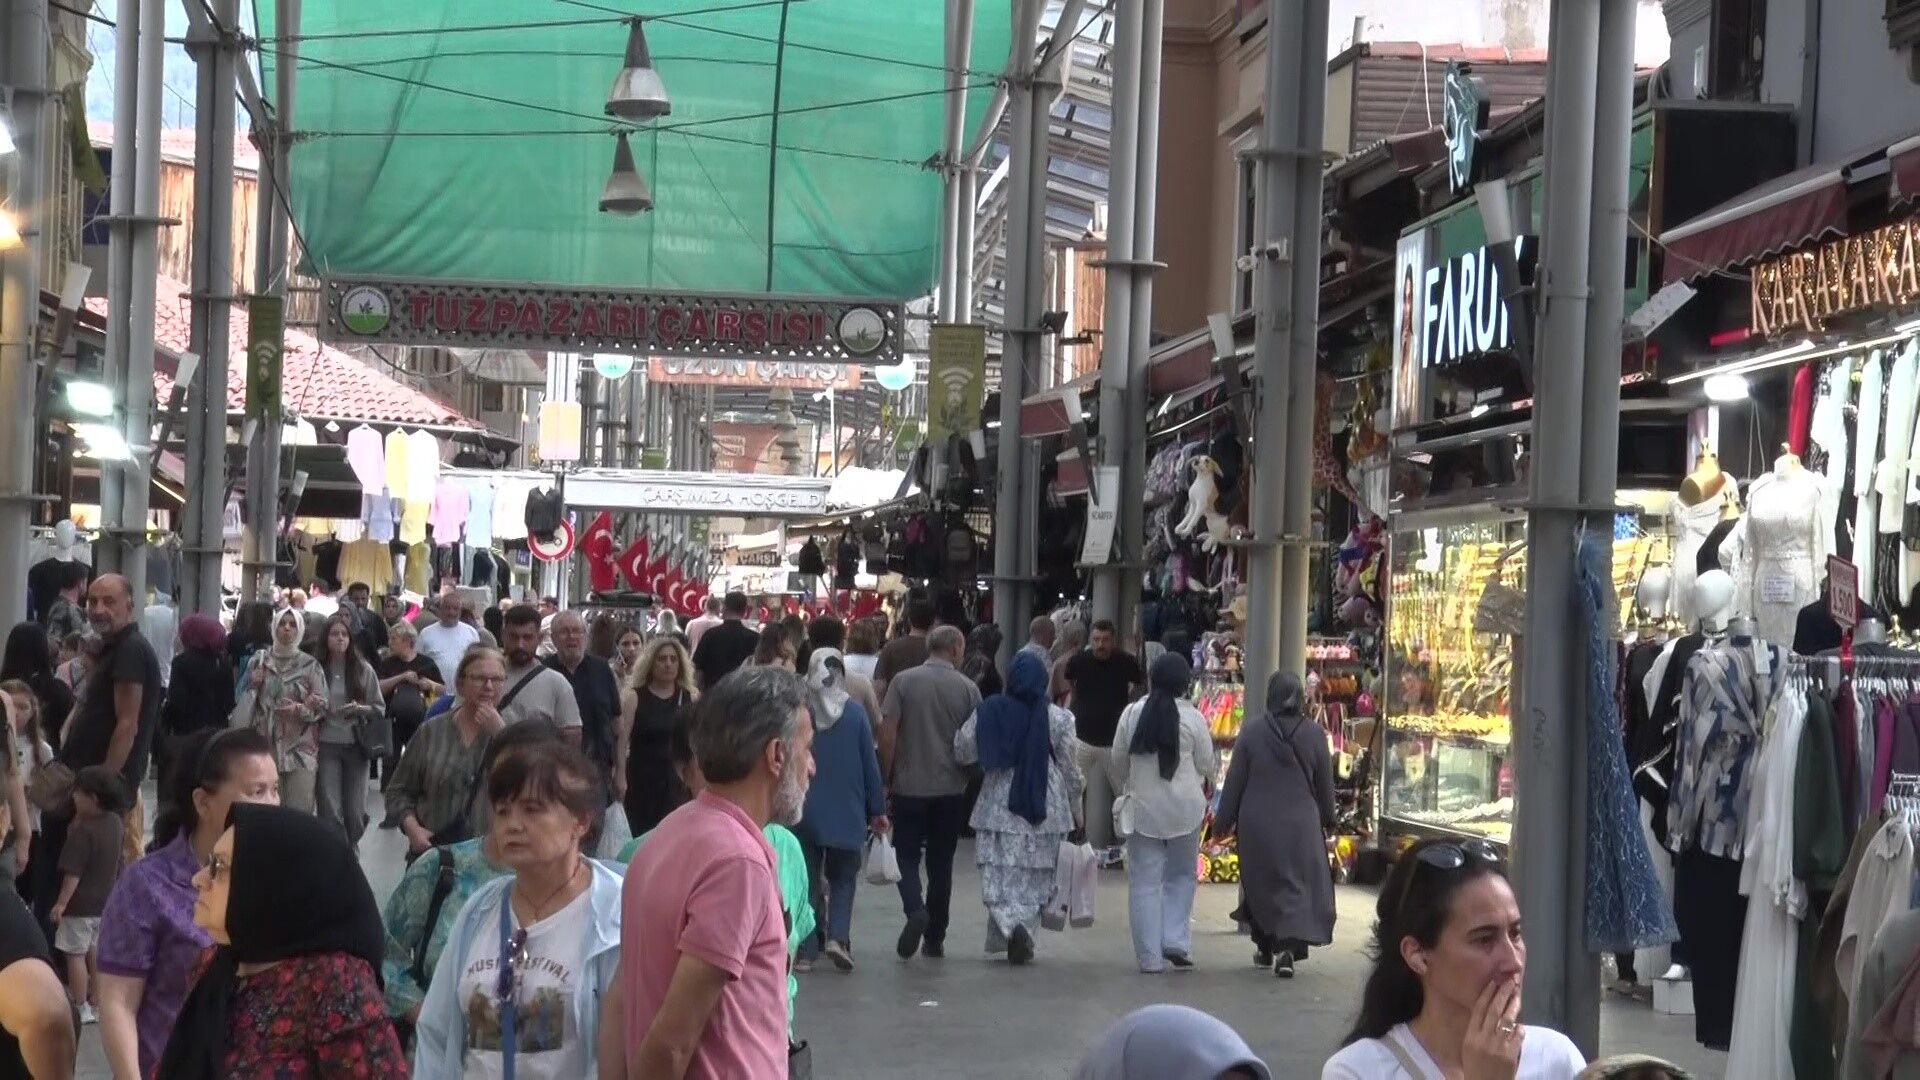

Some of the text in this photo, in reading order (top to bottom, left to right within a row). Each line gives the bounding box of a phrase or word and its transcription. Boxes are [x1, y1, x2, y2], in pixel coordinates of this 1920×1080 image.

[410, 294, 647, 338] TUZPAZARI
[655, 305, 826, 348] ÇARŞISI
[467, 958, 500, 978] MUSI
